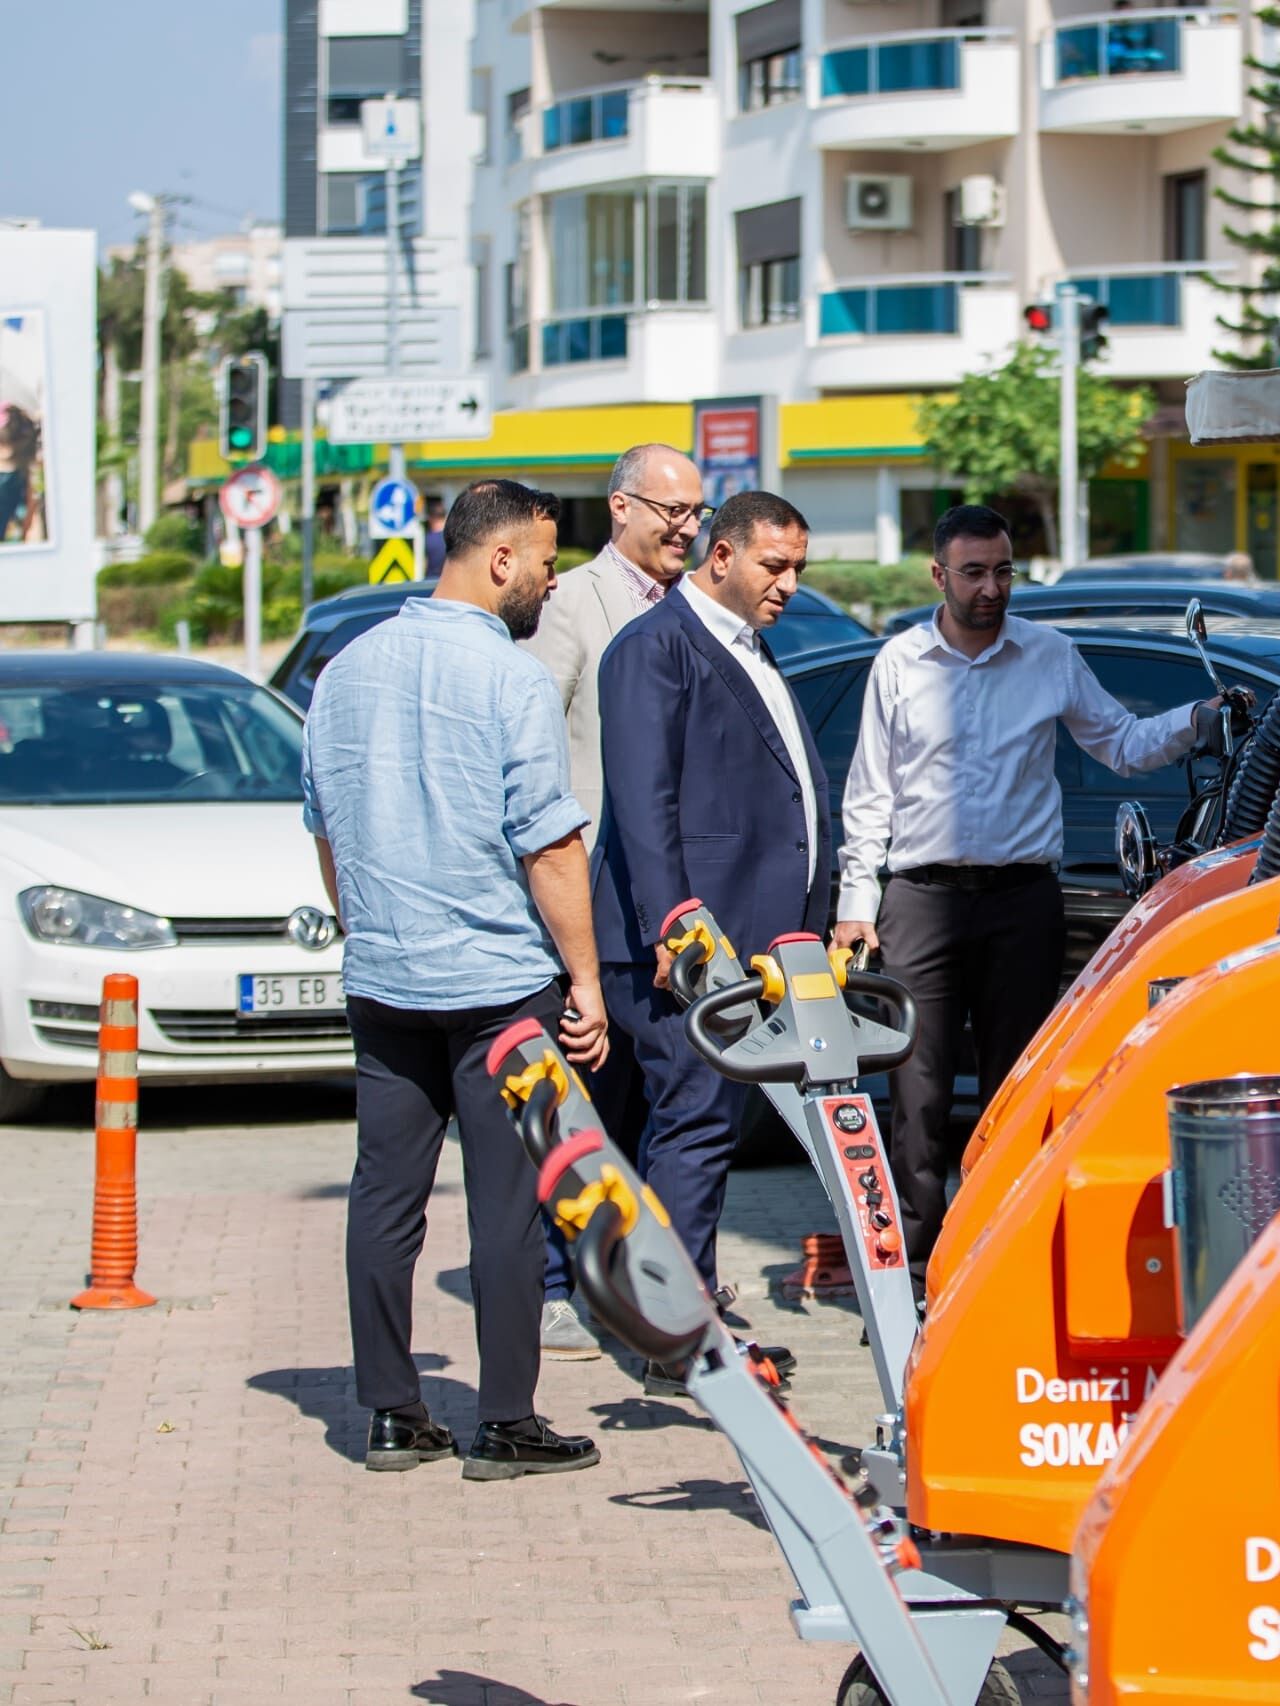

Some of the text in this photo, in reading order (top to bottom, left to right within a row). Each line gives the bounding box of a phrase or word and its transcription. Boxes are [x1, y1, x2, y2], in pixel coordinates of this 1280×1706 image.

[256, 980, 284, 1005] 35
[298, 978, 326, 1005] EB
[1016, 1367, 1130, 1403] Denizi
